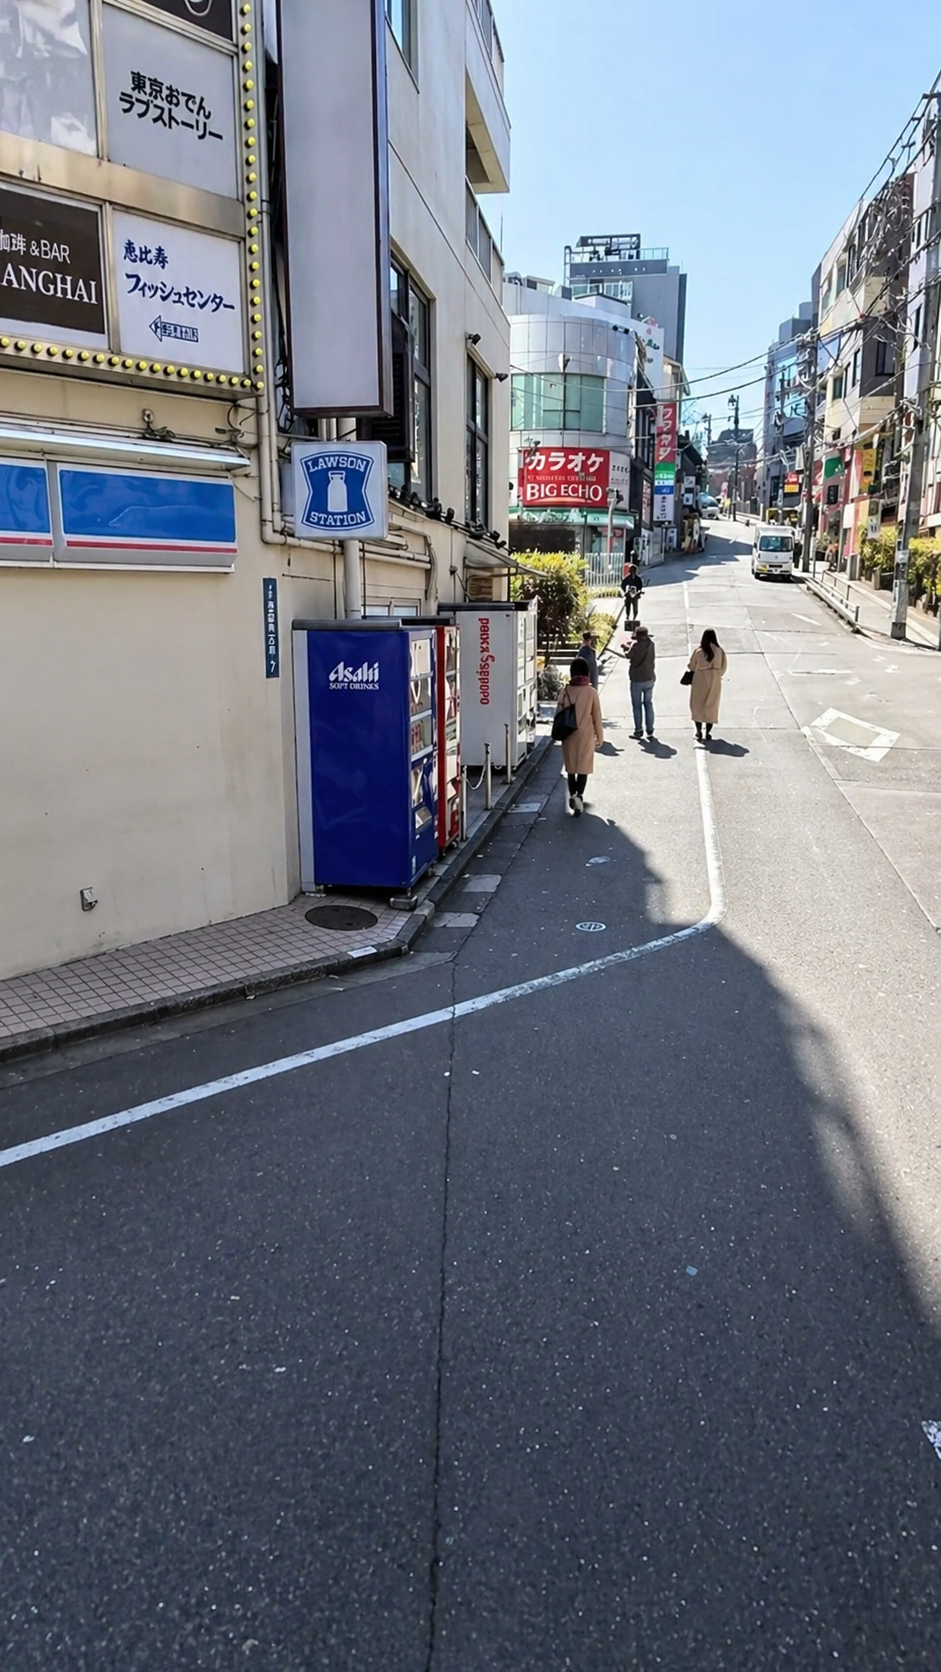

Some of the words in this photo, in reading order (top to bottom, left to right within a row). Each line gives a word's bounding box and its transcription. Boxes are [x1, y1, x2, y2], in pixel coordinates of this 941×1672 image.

[130, 71, 211, 120] 東京おでん
[119, 91, 223, 140] ラブストーリー
[124, 239, 169, 270] 恵比寿
[125, 272, 235, 312] フィッシュセンター
[307, 456, 367, 473] LAWSON
[525, 451, 604, 473] カラオケ
[526, 483, 558, 501] BIG
[560, 483, 603, 502] ECHO
[309, 510, 367, 526] STATION
[328, 661, 379, 682] Asahi
[329, 682, 348, 690] SOFT
